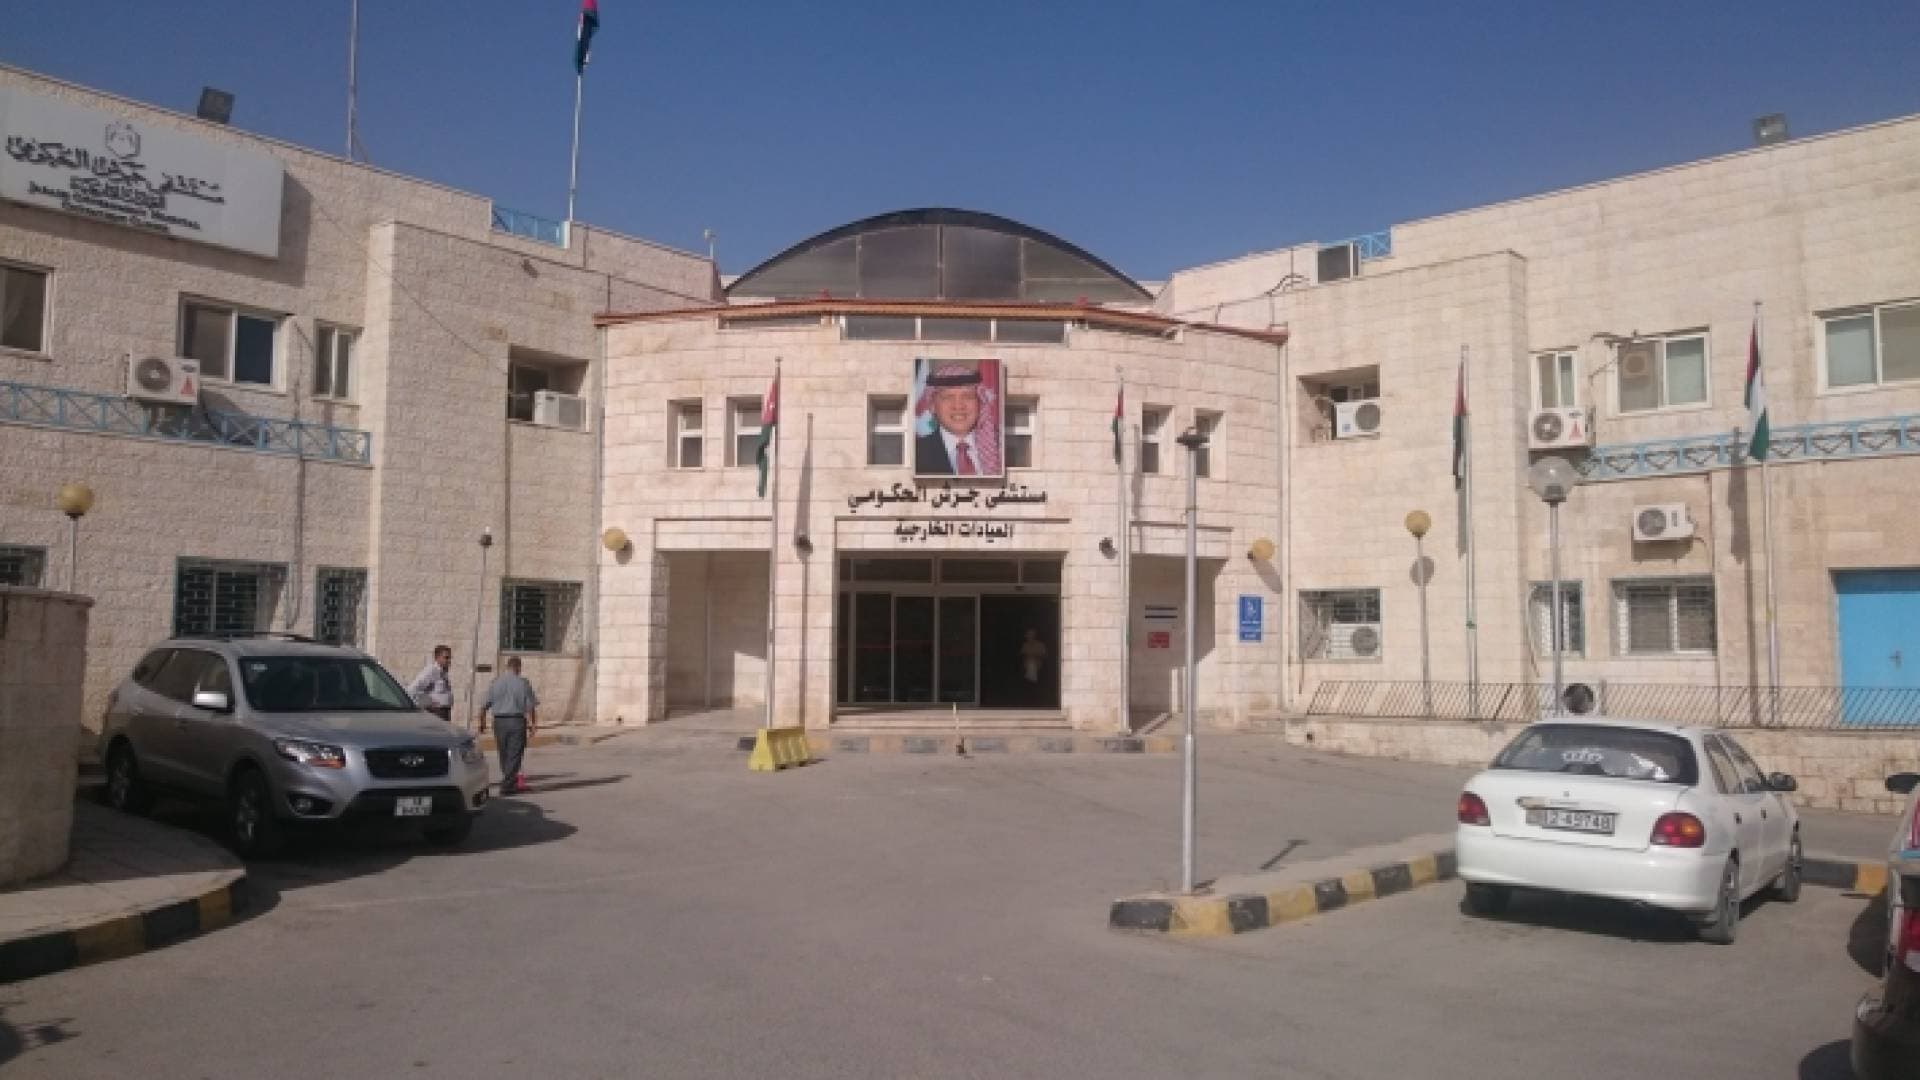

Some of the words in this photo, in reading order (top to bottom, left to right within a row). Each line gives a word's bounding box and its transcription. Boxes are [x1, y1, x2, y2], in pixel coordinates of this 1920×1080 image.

[848, 483, 928, 514] الحكومي
[931, 481, 981, 509] جرش
[894, 519, 954, 544] الخارجية
[959, 523, 1014, 544] العيادات
